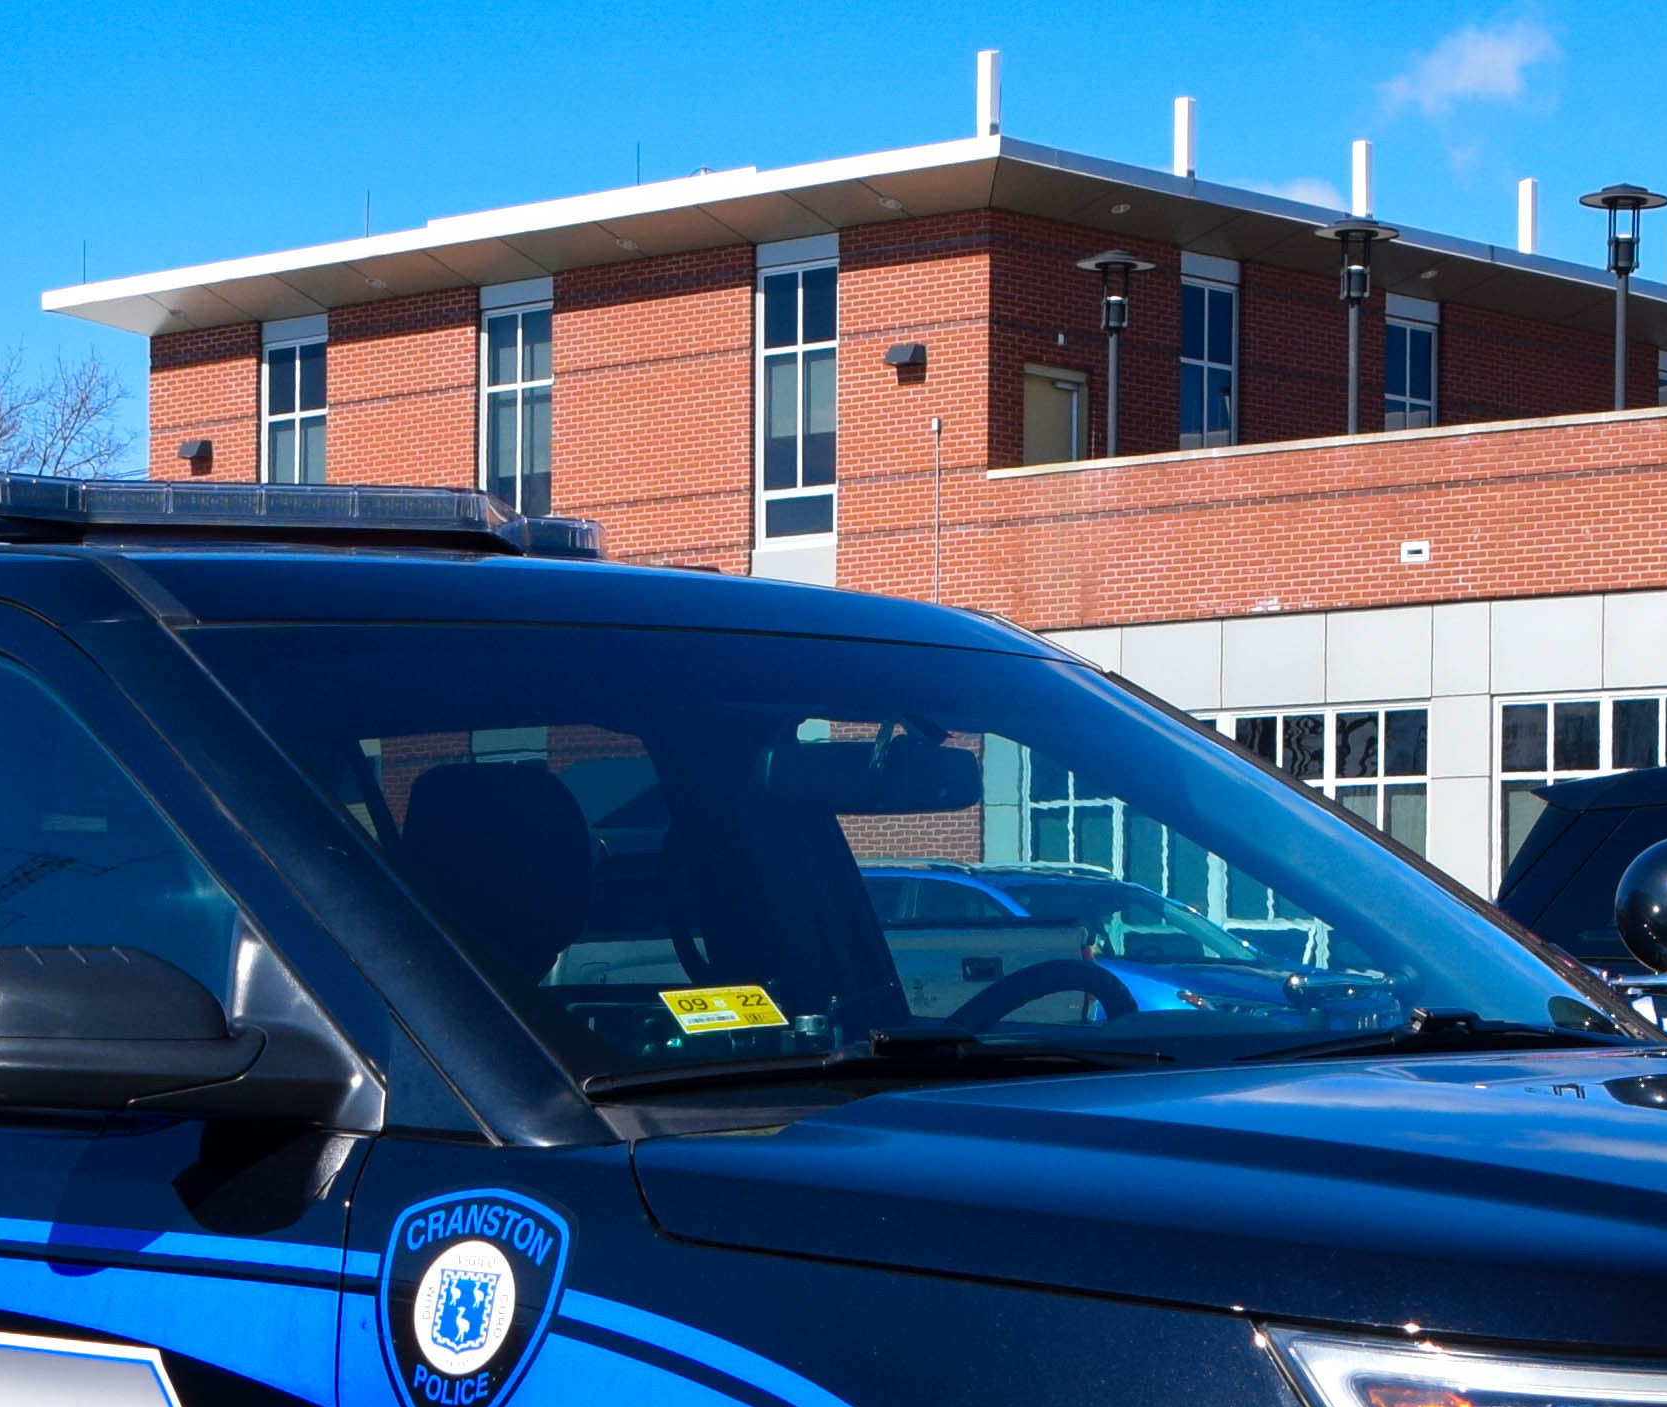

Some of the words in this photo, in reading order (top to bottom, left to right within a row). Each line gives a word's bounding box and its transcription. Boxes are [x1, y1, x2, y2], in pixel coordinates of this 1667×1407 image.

[677, 997, 709, 1013] 09
[736, 993, 769, 1008] 22
[406, 1204, 554, 1267] CRANSTON
[413, 1363, 490, 1406] POLICE
